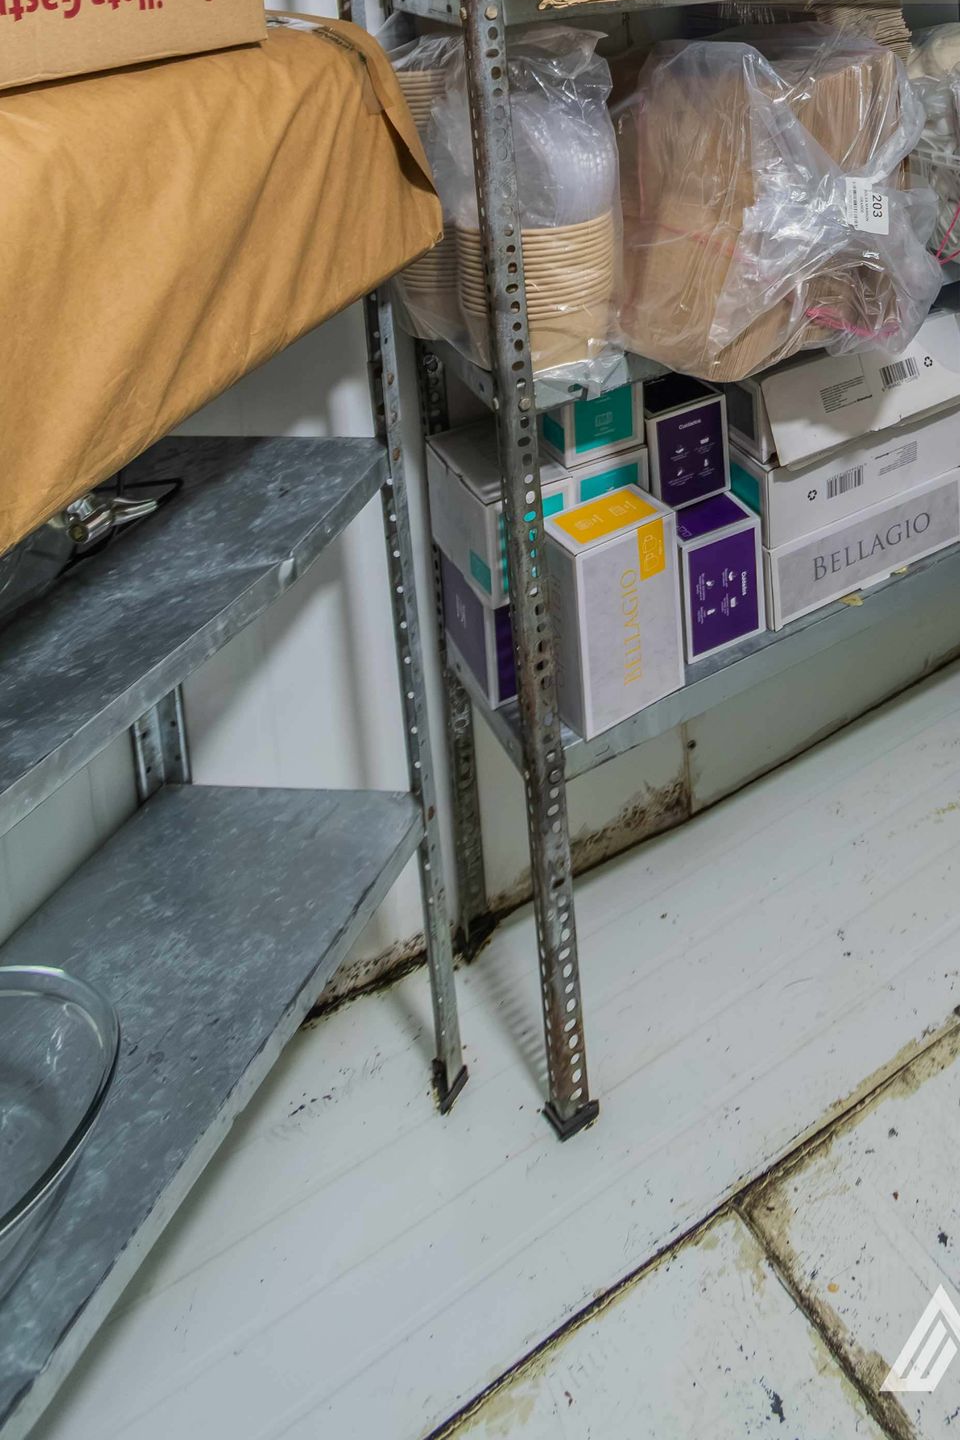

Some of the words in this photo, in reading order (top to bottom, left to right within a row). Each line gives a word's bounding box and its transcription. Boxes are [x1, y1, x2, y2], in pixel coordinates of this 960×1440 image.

[872, 195, 882, 218] 203
[812, 511, 931, 582] BELLAGIO
[619, 568, 643, 687] BELLAGIO
